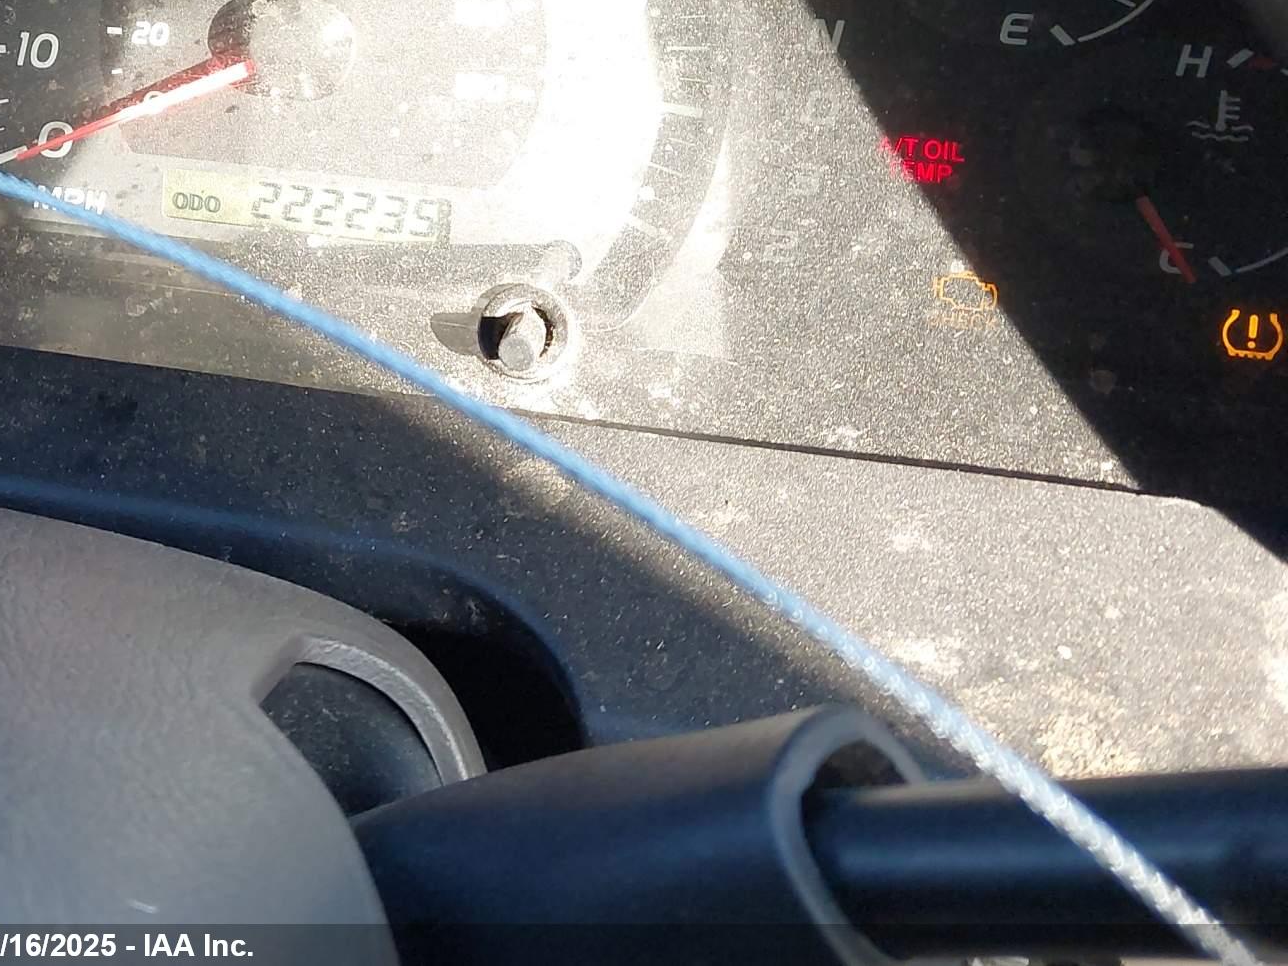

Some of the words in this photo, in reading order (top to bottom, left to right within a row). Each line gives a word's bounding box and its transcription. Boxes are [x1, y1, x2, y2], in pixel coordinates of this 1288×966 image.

[132, 19, 170, 47] 20
[1000, 13, 1034, 46] E
[16, 32, 60, 70] 10
[1175, 44, 1213, 78] H
[36, 121, 73, 159] 0
[924, 138, 965, 163] OIL
[172, 191, 222, 214] ODO
